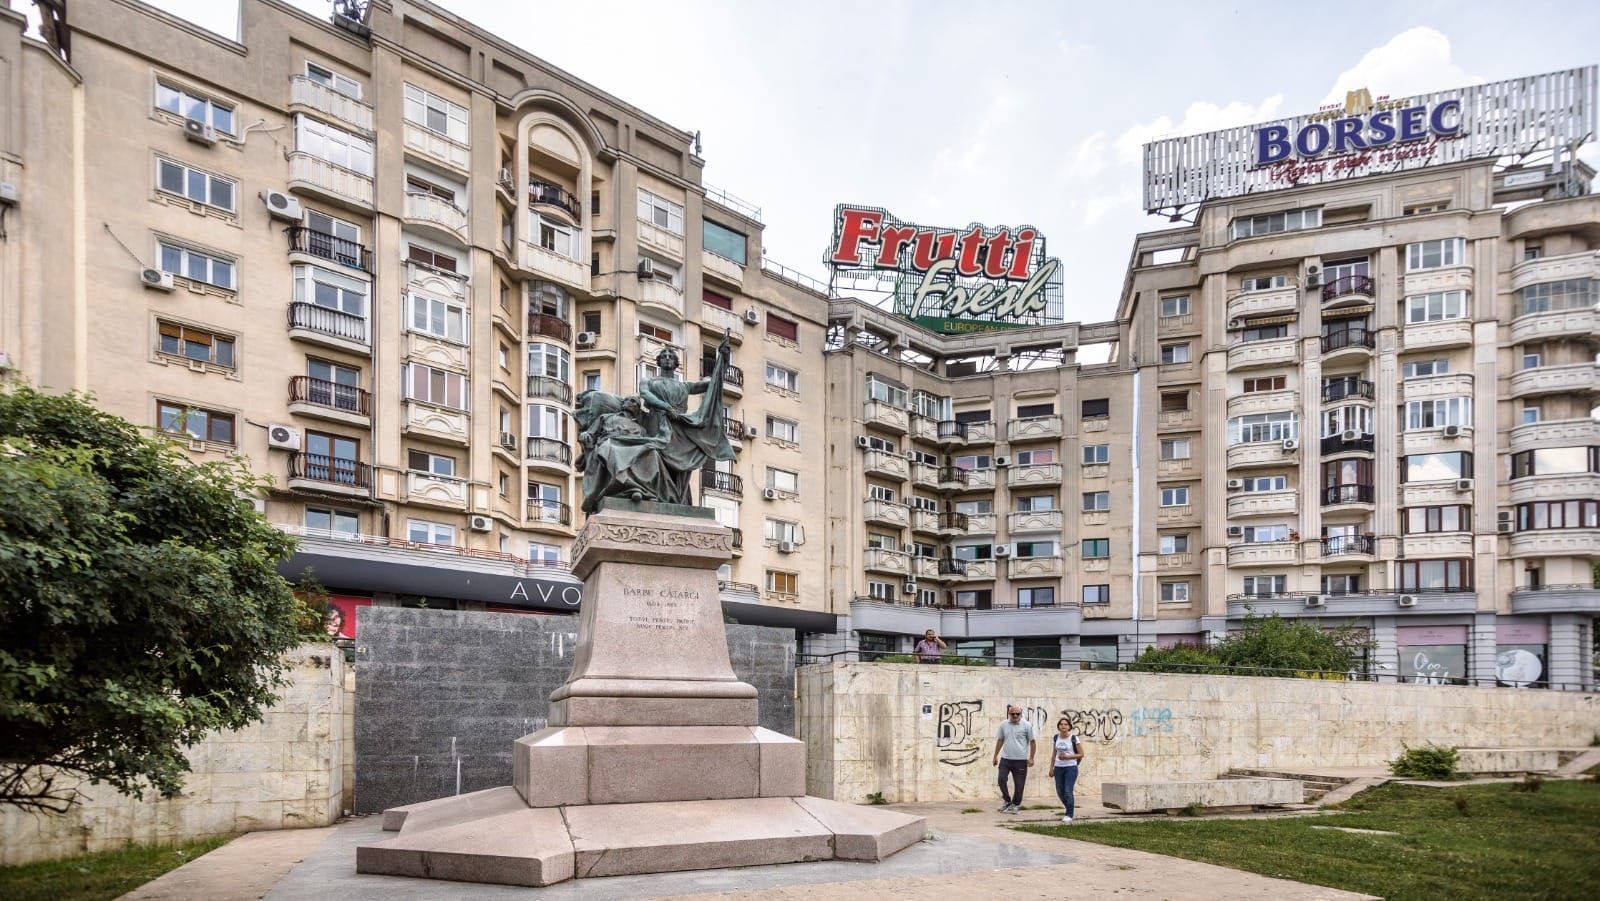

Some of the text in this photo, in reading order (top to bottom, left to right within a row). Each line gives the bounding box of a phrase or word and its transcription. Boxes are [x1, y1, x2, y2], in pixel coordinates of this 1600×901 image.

[1257, 100, 1461, 164] BORSEC
[832, 208, 1037, 280] Frutti
[909, 258, 1059, 321] Fresh
[660, 589, 700, 600] CATARGI
